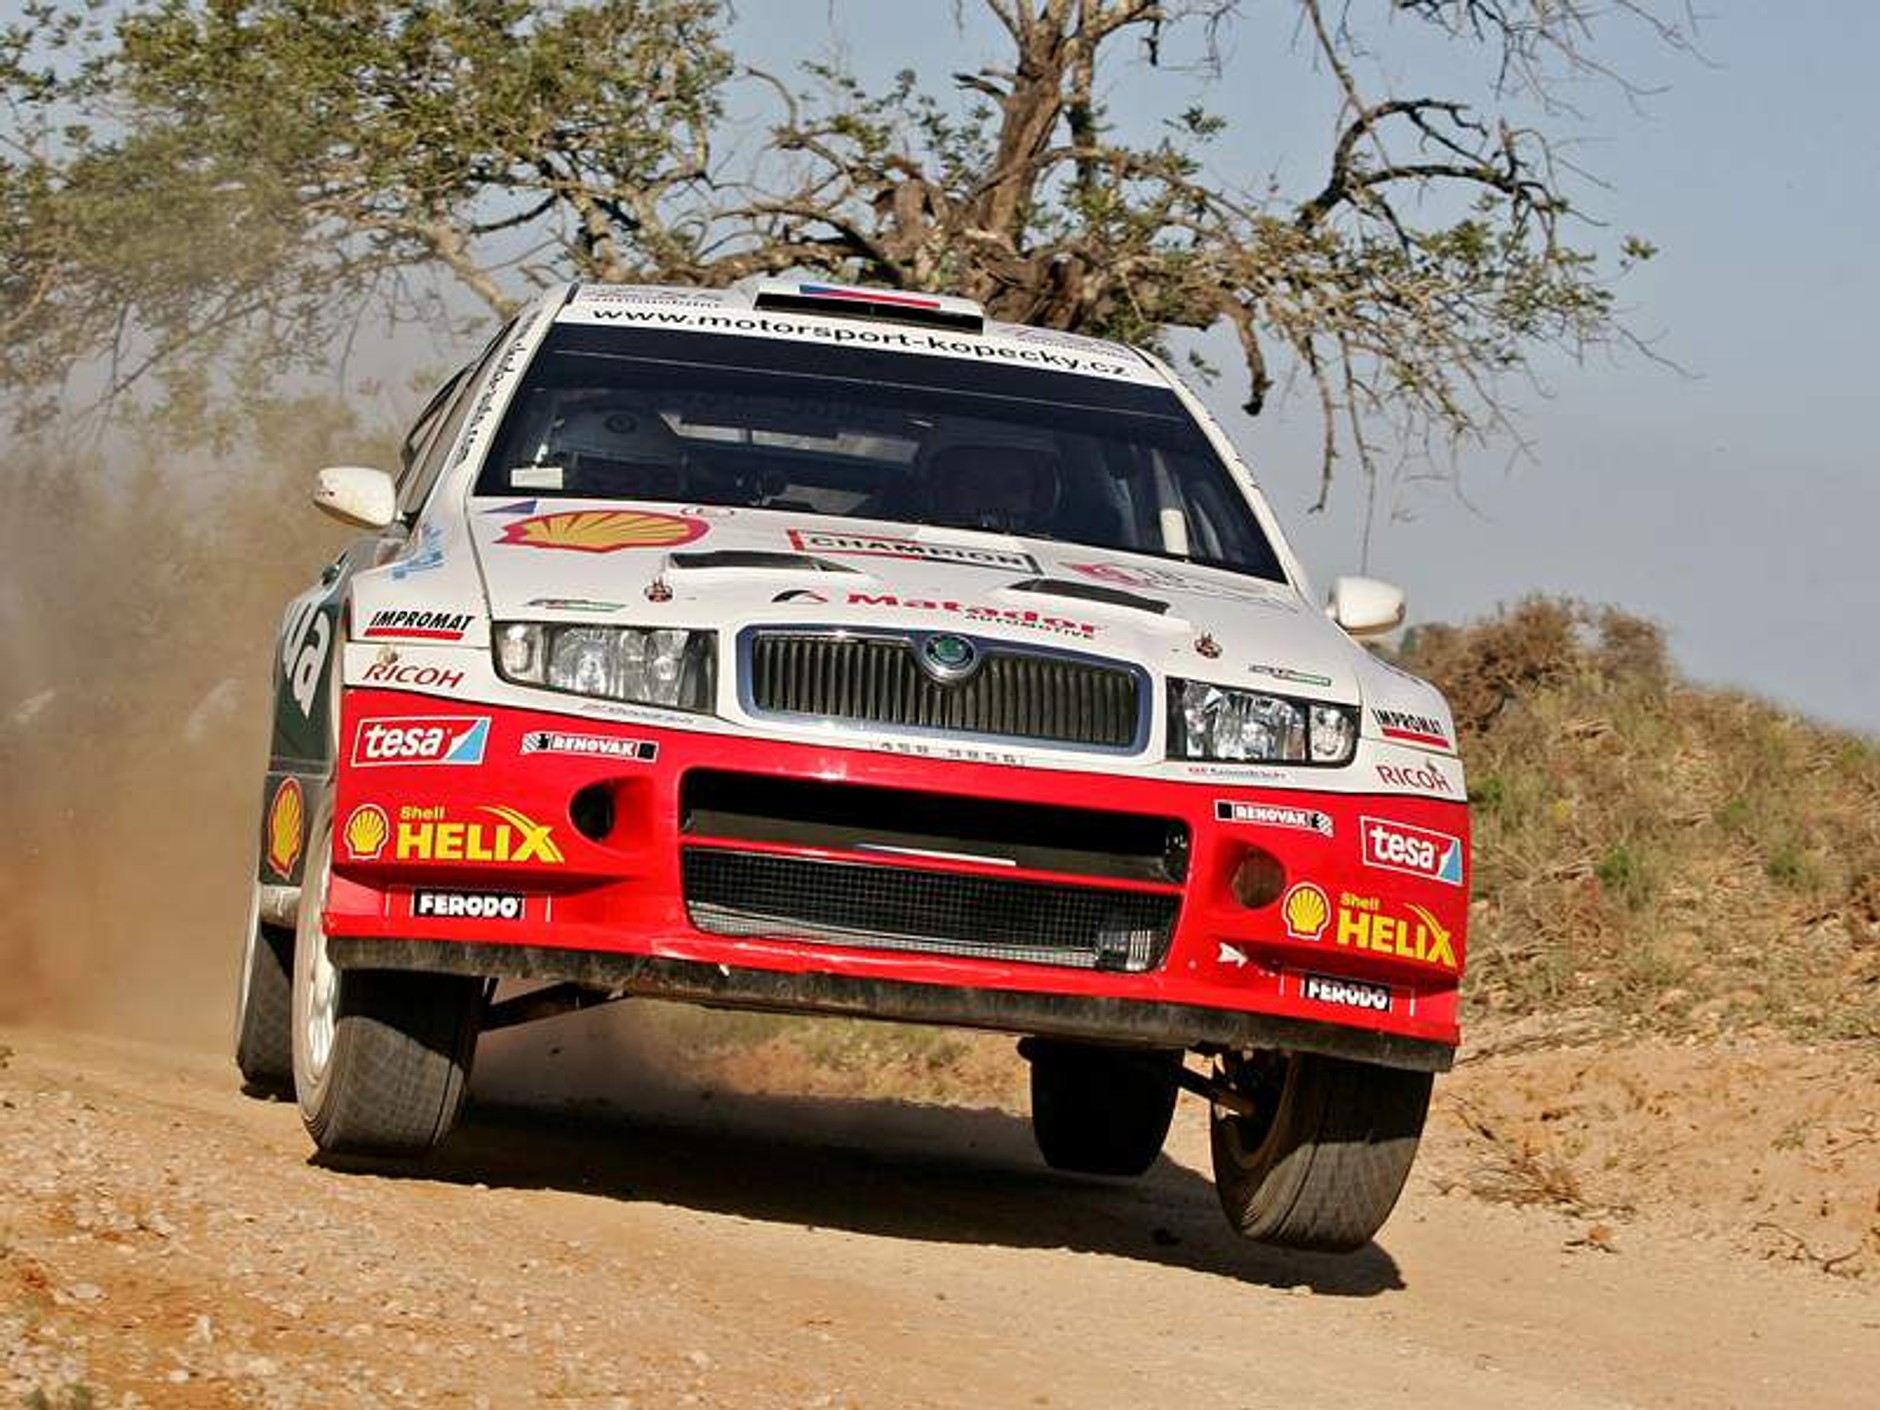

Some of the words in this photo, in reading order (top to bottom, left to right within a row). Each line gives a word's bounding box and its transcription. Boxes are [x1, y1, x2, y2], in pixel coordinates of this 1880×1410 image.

[594, 310, 1129, 376] www.motorsport-kopecky.cz
[810, 536, 1024, 568] CHAMPION
[369, 611, 475, 632] IMPROMAT
[848, 593, 1098, 634] Matador
[964, 612, 1095, 641] AUTOMOTIVE
[362, 663, 465, 689] RICOH
[364, 723, 444, 758] tesa
[1376, 765, 1453, 793] RICOH
[400, 806, 444, 820] Shell
[397, 807, 564, 863] HELIX
[1370, 825, 1435, 869] tesa
[418, 892, 519, 918] FERODO
[1341, 892, 1380, 911] Shell
[1336, 904, 1457, 968] HELIX
[1308, 977, 1389, 1009] FERODO
